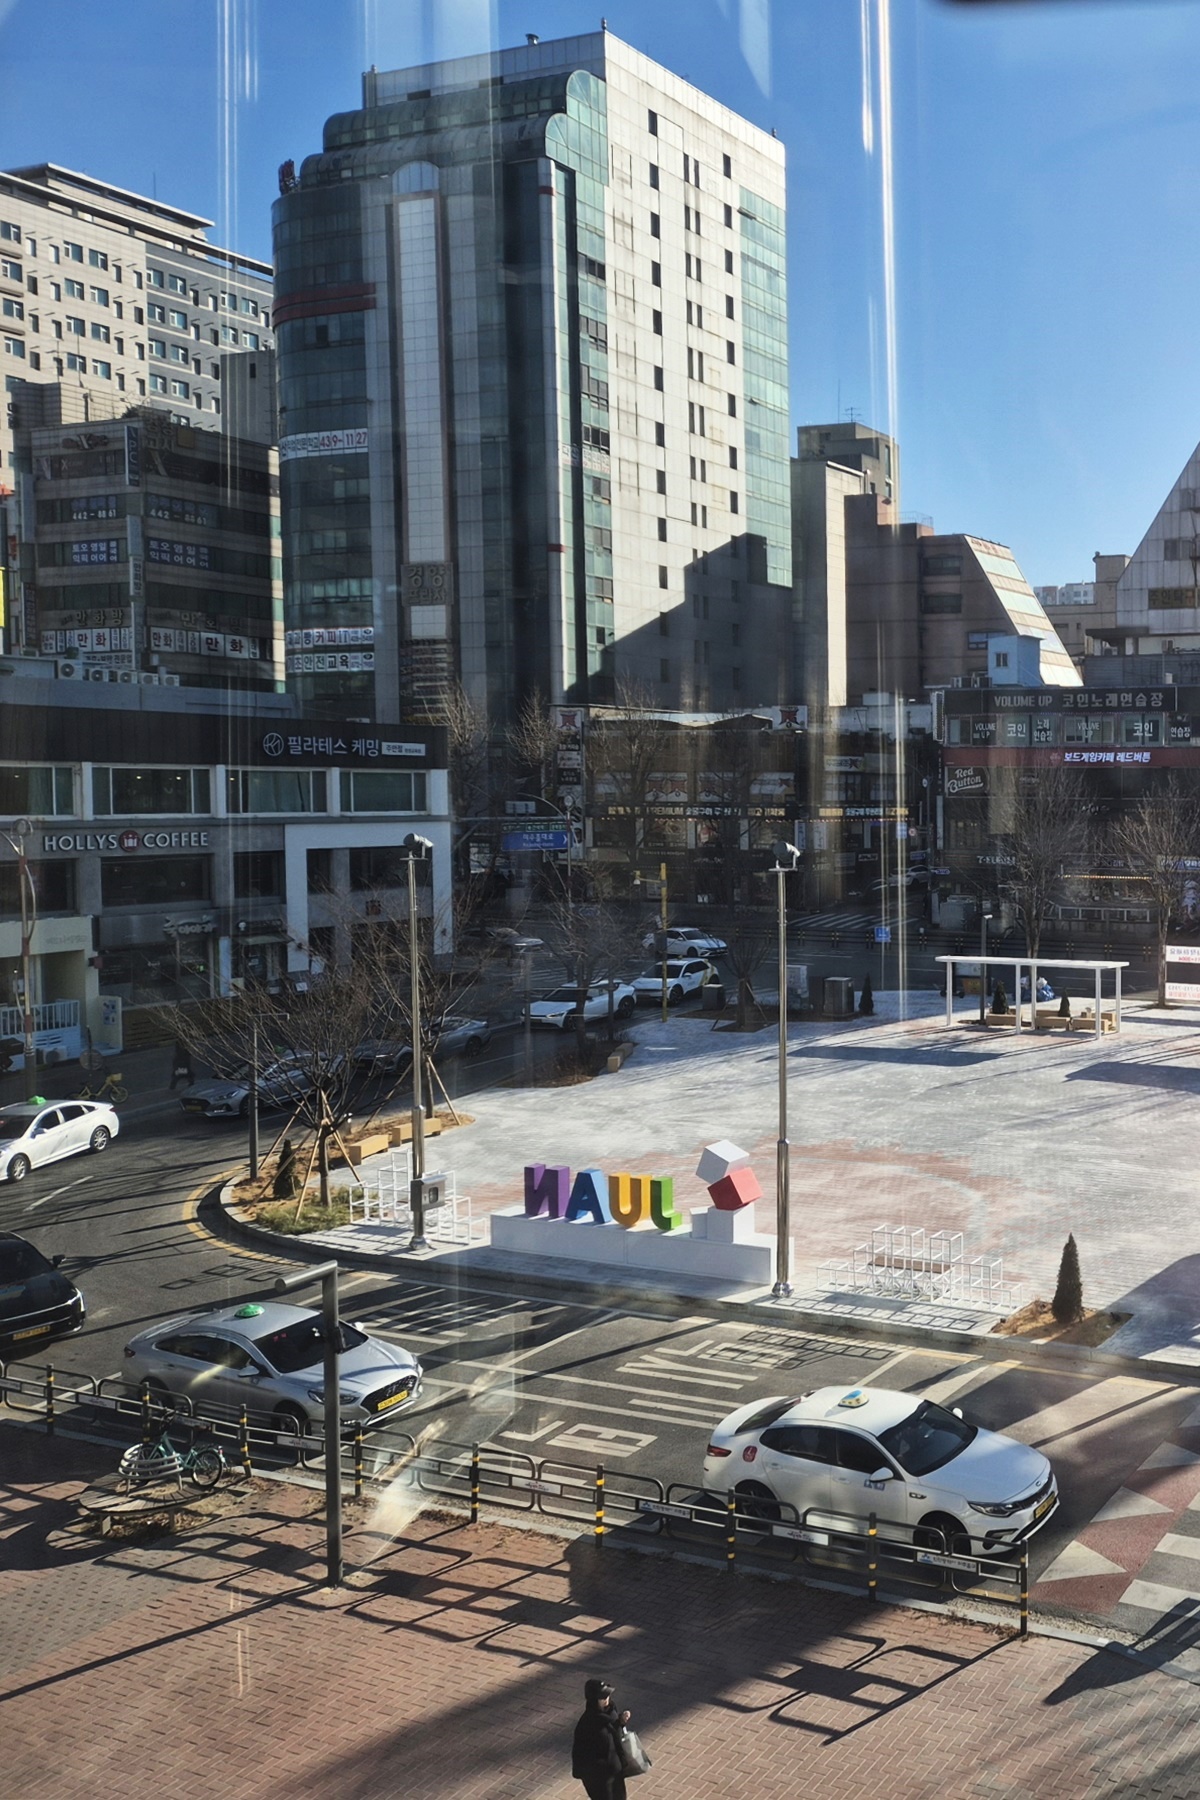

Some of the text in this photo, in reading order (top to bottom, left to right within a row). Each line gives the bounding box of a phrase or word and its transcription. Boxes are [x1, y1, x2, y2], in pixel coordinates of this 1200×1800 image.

[75, 609, 123, 626] 만화방
[77, 632, 106, 647] 만화
[153, 632, 172, 648] 만화
[205, 637, 244, 653] 만화
[994, 692, 1164, 708] VOLUME UP 코인노래연습장
[1007, 723, 1026, 737] 코인
[1133, 722, 1153, 737] 코인
[287, 736, 380, 757] 필라테스 케밍
[955, 767, 974, 778] Red
[947, 775, 984, 795] Button
[44, 832, 209, 852] HOLLYS COFFEE
